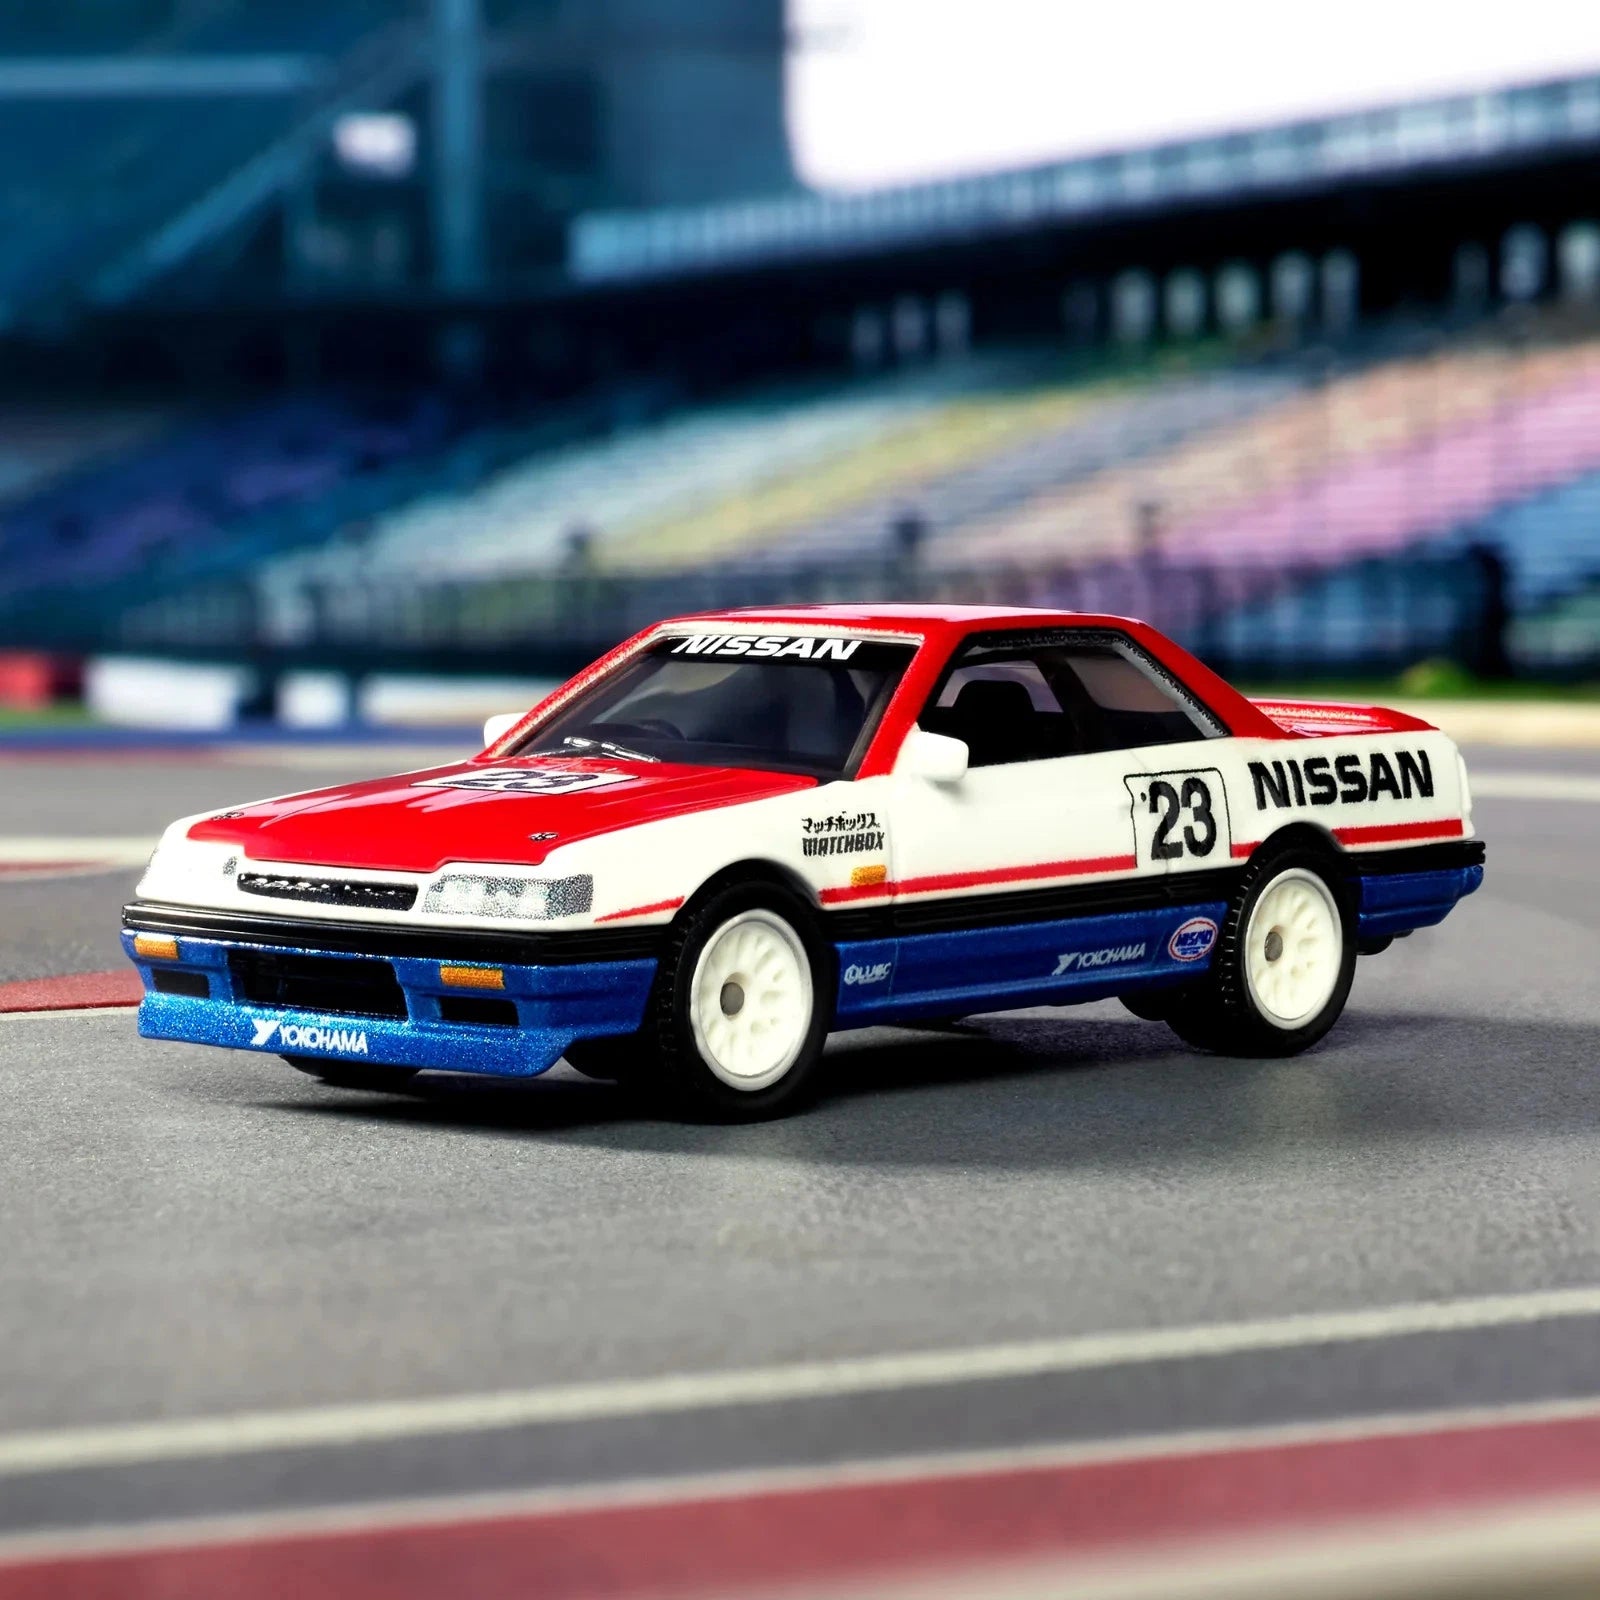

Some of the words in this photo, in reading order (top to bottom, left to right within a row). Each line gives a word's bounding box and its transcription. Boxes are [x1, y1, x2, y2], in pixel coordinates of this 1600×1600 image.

[670, 634, 863, 661] NISSAN
[440, 770, 599, 790] 23
[1247, 750, 1434, 810] NISSAN
[1149, 777, 1217, 860] 23
[801, 832, 885, 857] MATCHBOX
[1077, 942, 1147, 970] YOKOHAMA
[279, 1024, 368, 1054] YOKOHAMA
